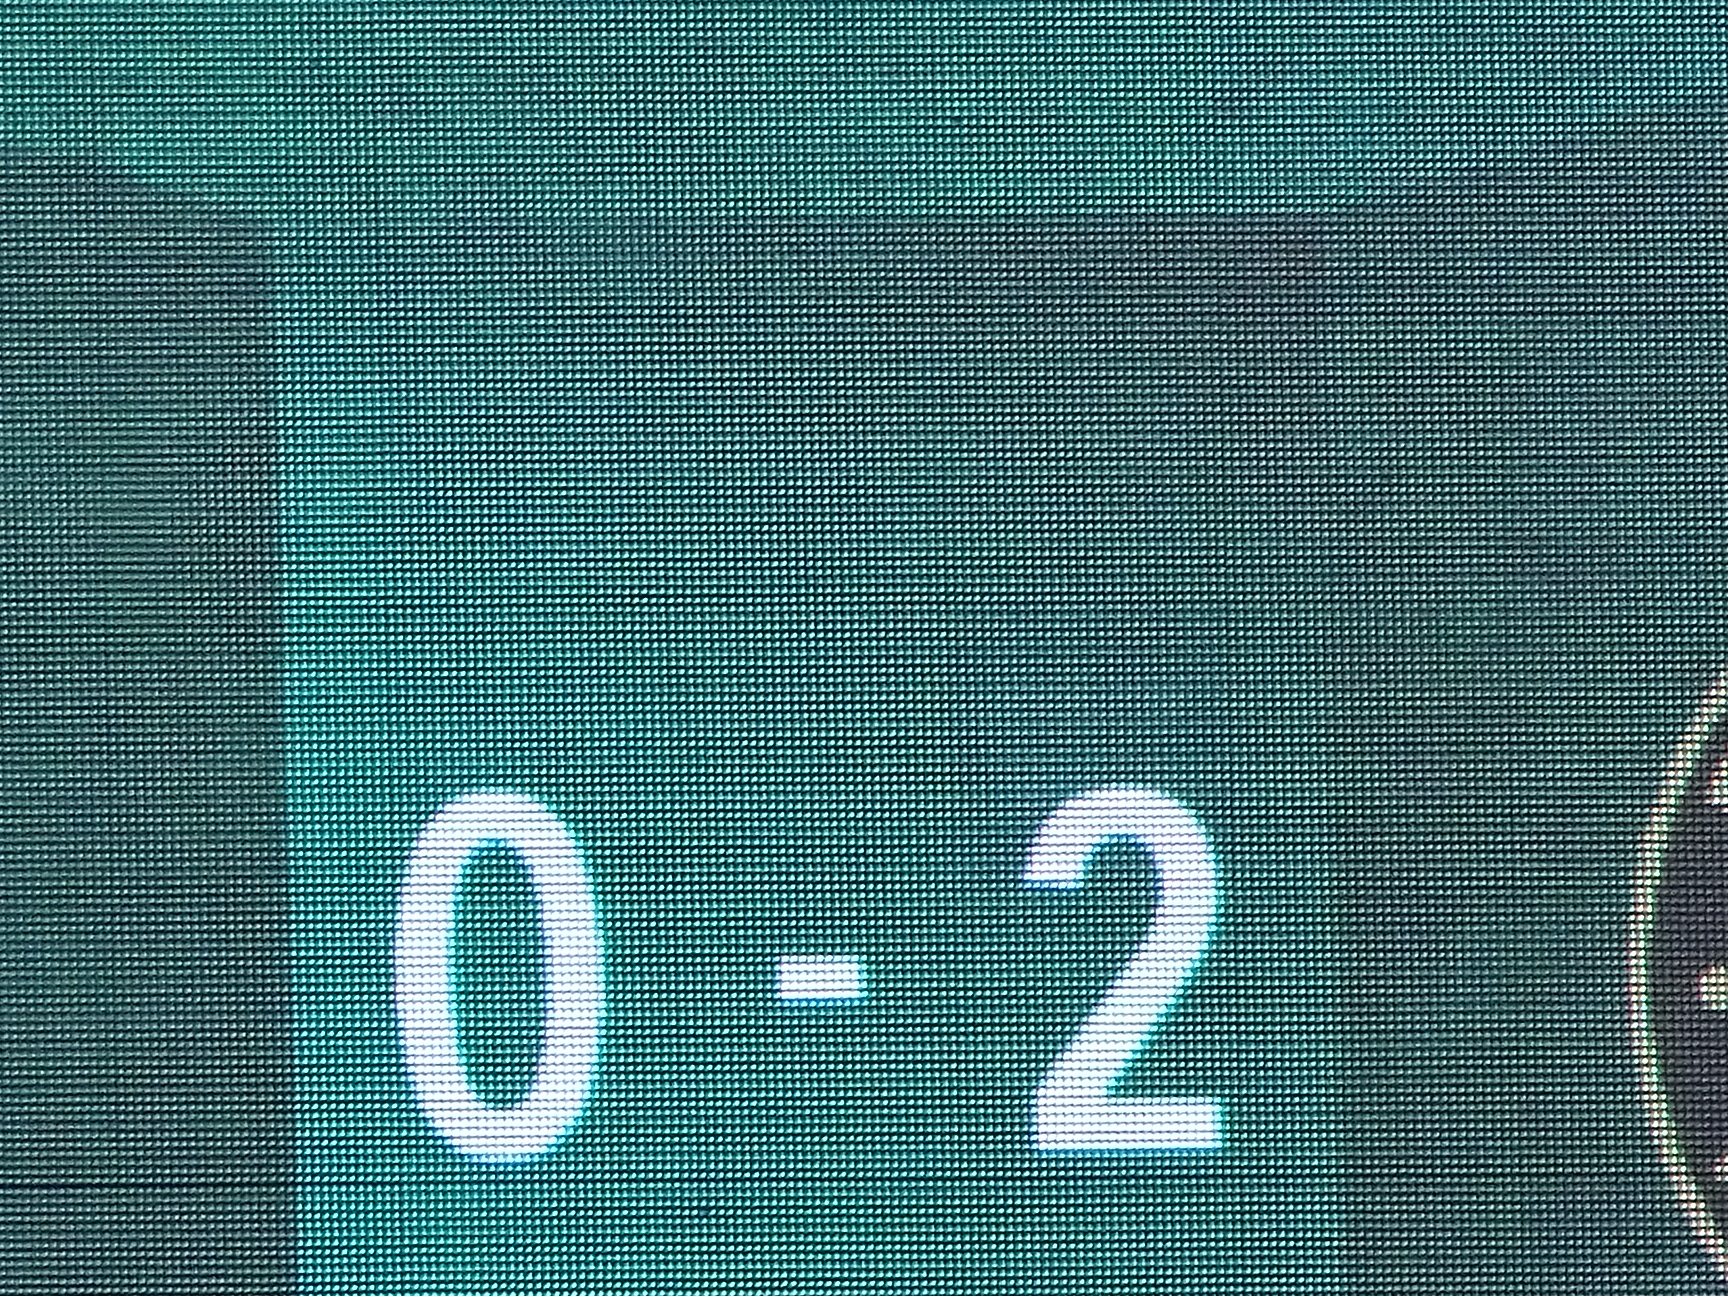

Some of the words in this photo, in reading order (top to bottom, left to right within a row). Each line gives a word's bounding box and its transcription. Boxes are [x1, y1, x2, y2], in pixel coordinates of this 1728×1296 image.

[393, 789, 606, 1165] 0
[775, 952, 868, 1003] -
[1023, 785, 1227, 1153] 2
